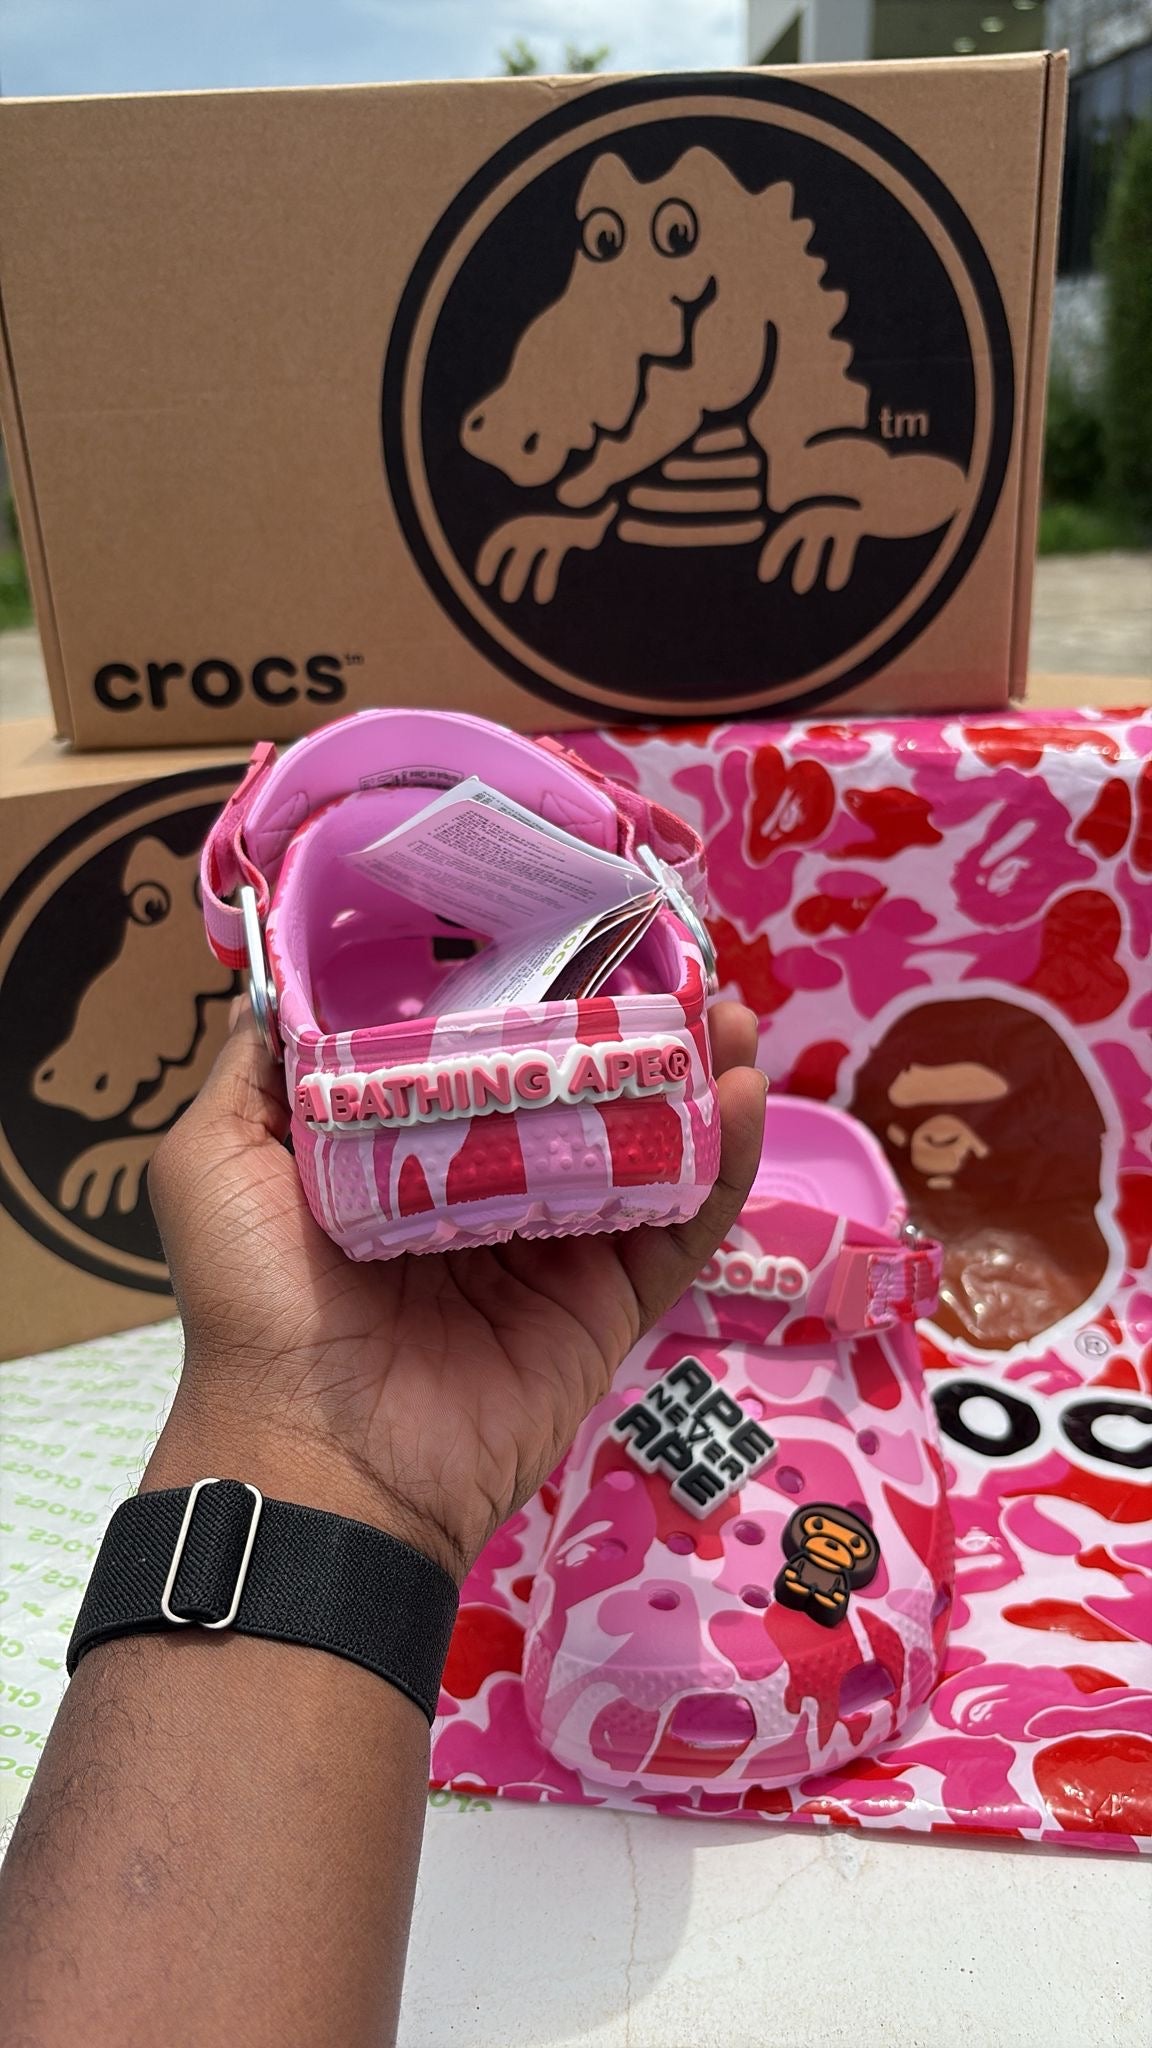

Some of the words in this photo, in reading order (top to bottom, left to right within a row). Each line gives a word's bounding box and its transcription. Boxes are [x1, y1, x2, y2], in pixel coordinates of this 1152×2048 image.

[879, 405, 929, 438] tm
[542, 924, 588, 976] rocs
[330, 1064, 549, 1122] BATHING
[697, 1257, 803, 1296] croc
[647, 1383, 744, 1481] NEVER
[666, 1358, 775, 1464] APE
[931, 1380, 1152, 1470] oc
[615, 1403, 726, 1506] APE
